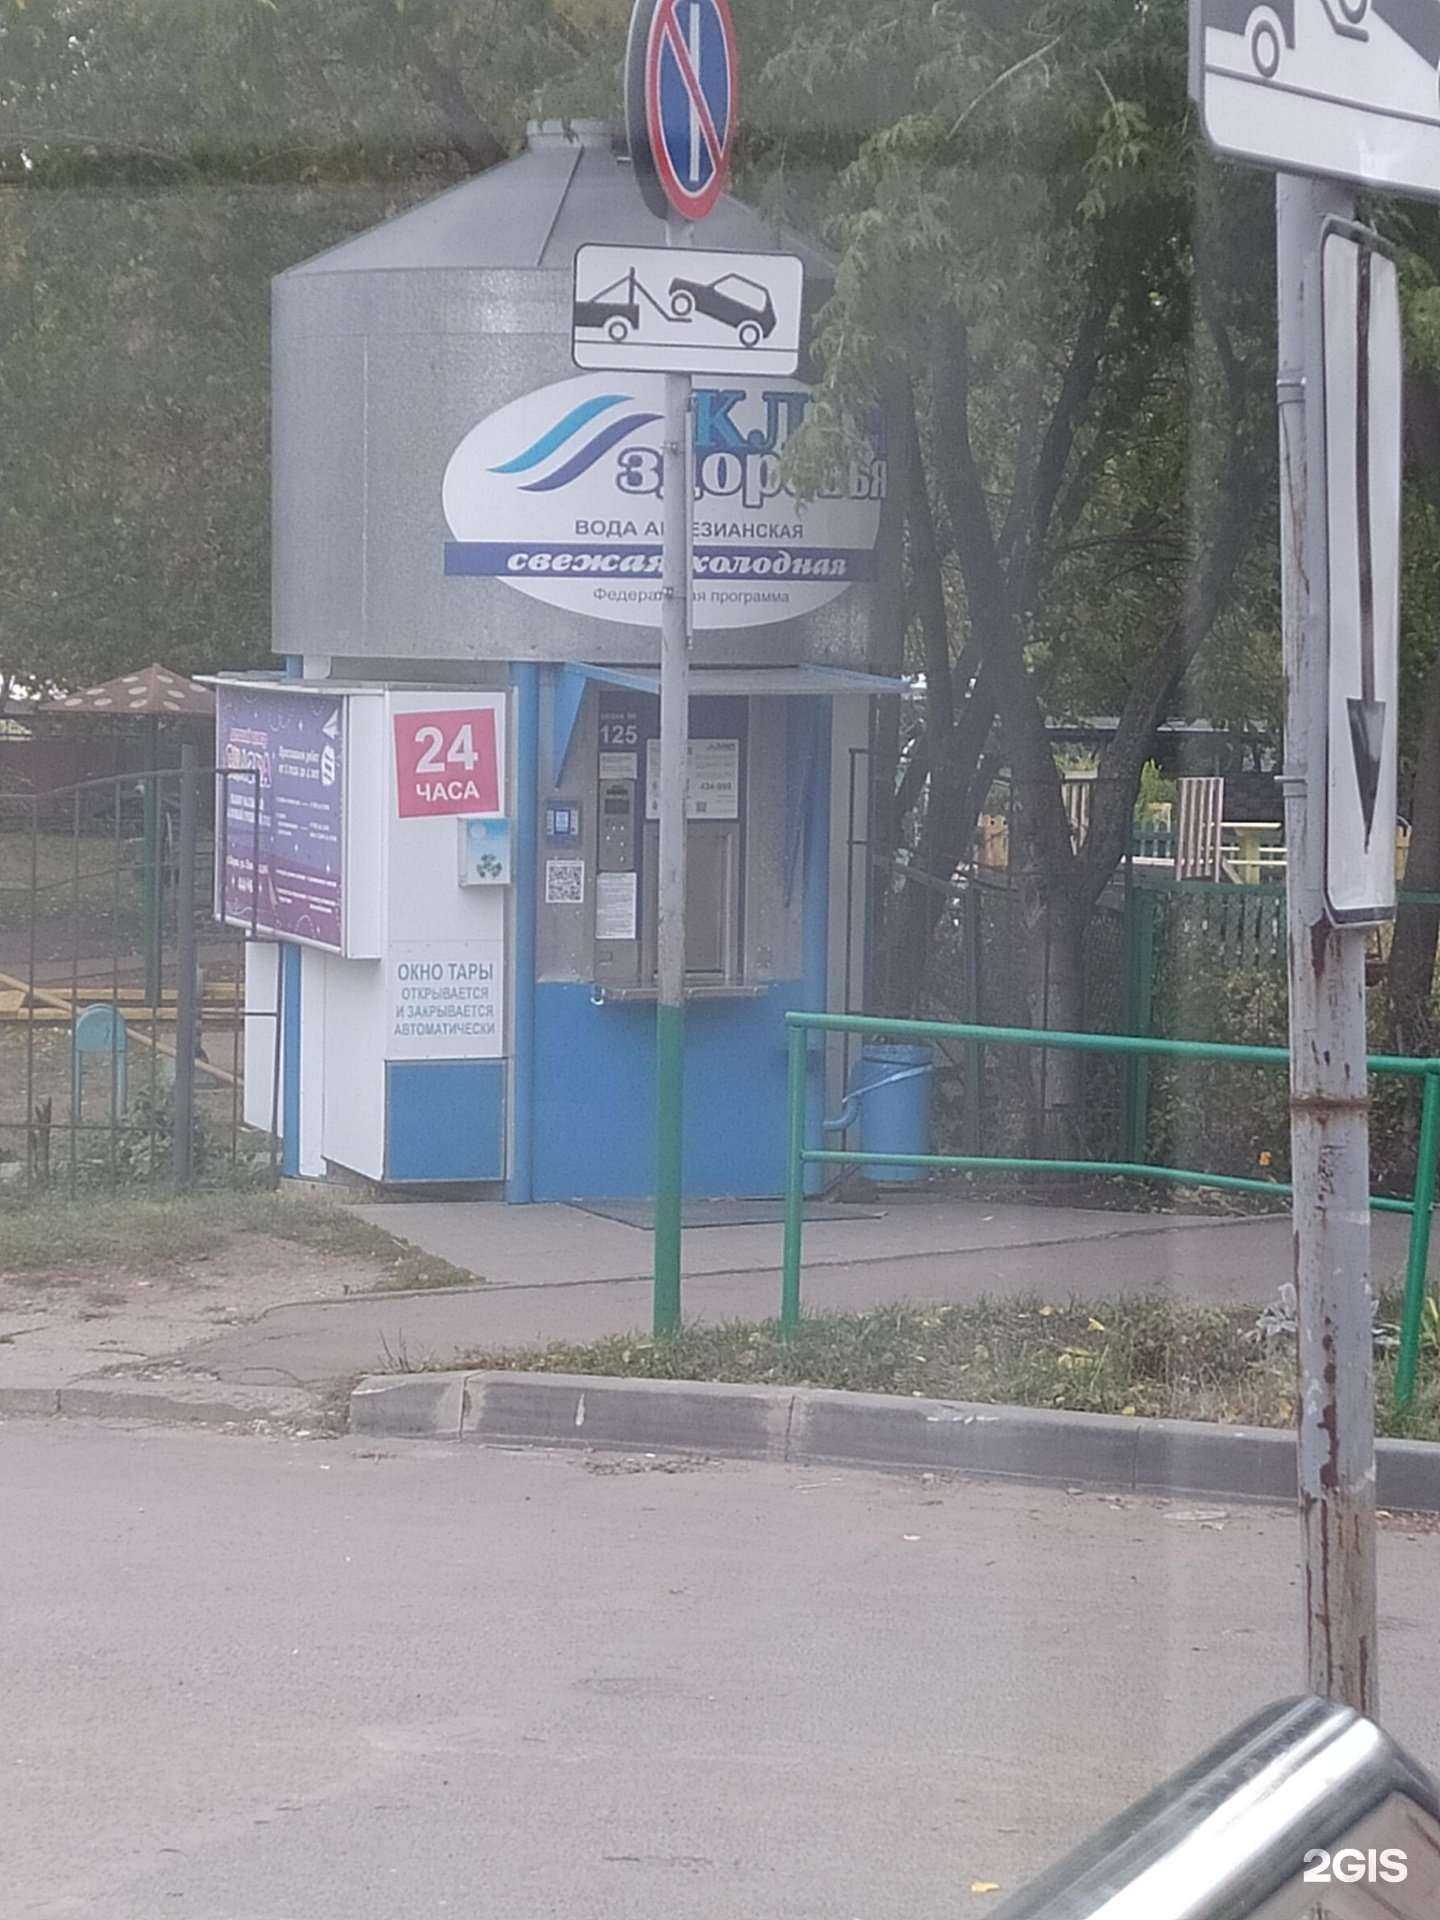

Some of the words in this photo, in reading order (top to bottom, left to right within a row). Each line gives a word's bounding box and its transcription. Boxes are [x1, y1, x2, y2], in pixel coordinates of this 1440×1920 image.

[575, 520, 638, 538] ВОДА
[644, 521, 804, 539] АЕЗИАНСКАЯ
[507, 552, 663, 573] свежая
[711, 590, 790, 604] программа
[600, 725, 637, 744] 125
[415, 725, 479, 773] 24
[416, 780, 480, 801] ЧАСА
[398, 963, 443, 981] ОКНО
[448, 963, 493, 981] ТАРЫ
[402, 986, 489, 1001] ОТКРЫВАЕТСЯ
[395, 1005, 405, 1018] И
[407, 1004, 494, 1018] ЗАКРЫВАЕТСЯ
[394, 1022, 495, 1036] АВТОМАТИЧЕСКИ
